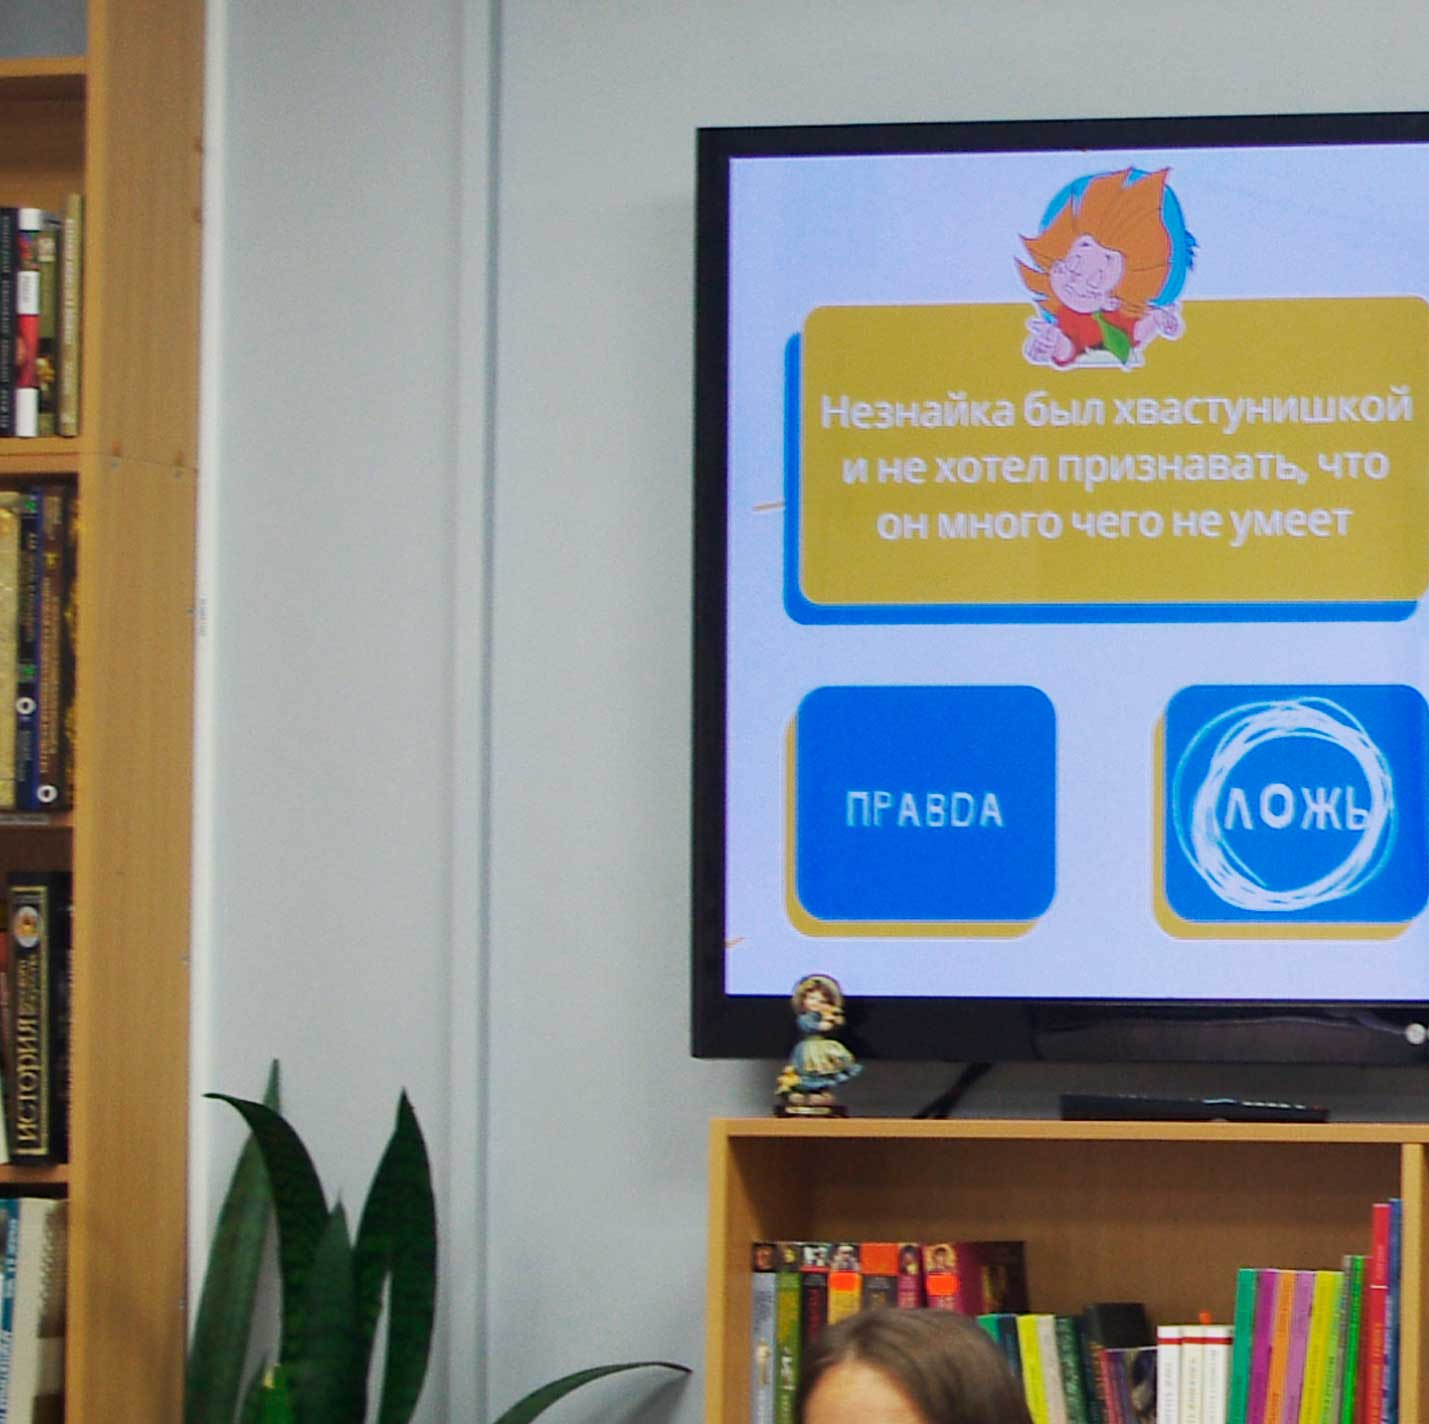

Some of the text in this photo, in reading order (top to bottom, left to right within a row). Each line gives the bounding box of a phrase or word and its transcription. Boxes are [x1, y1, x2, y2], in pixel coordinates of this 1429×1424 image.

[820, 385, 1414, 435] Незнайка был хвастунишкой
[842, 450, 1390, 491] и не хотел признавать, что
[876, 507, 1353, 547] он много чего не умеет
[845, 790, 1005, 828] ПРАВДА
[1223, 783, 1372, 832] ЛОЖЬ
[17, 1016, 42, 1142] ИСТОРИЯ
